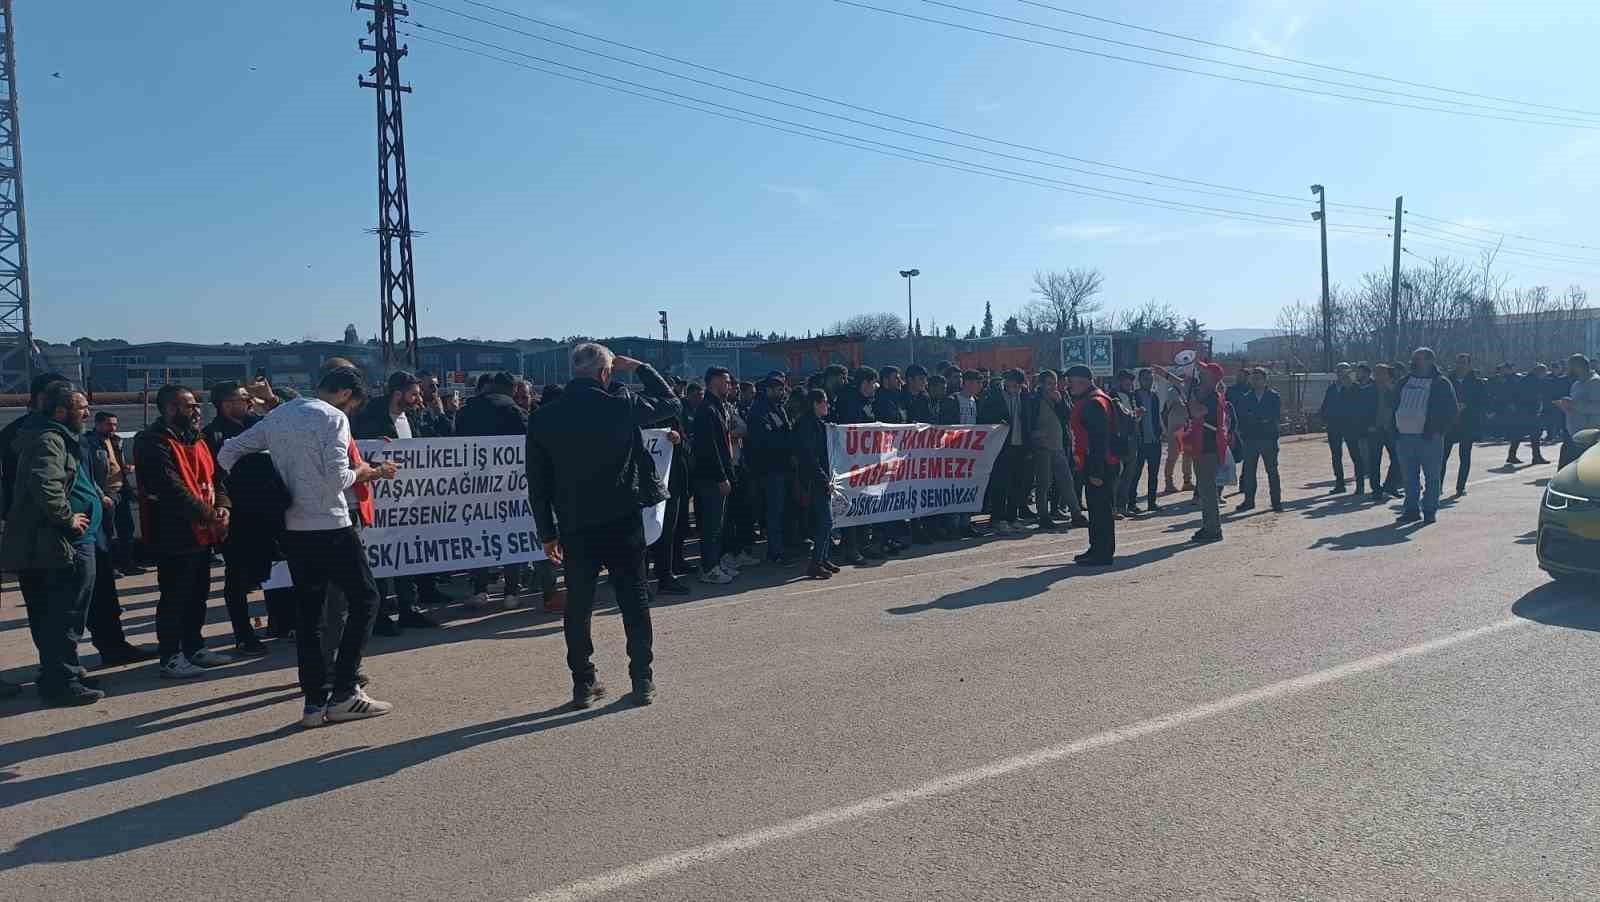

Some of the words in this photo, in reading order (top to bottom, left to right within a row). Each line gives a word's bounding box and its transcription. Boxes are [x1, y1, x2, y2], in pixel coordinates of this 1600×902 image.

[382, 443, 468, 470] TEHLİKELİ
[473, 443, 488, 471] İŞ
[372, 471, 503, 502] YAŞAYACAĞIMIZ
